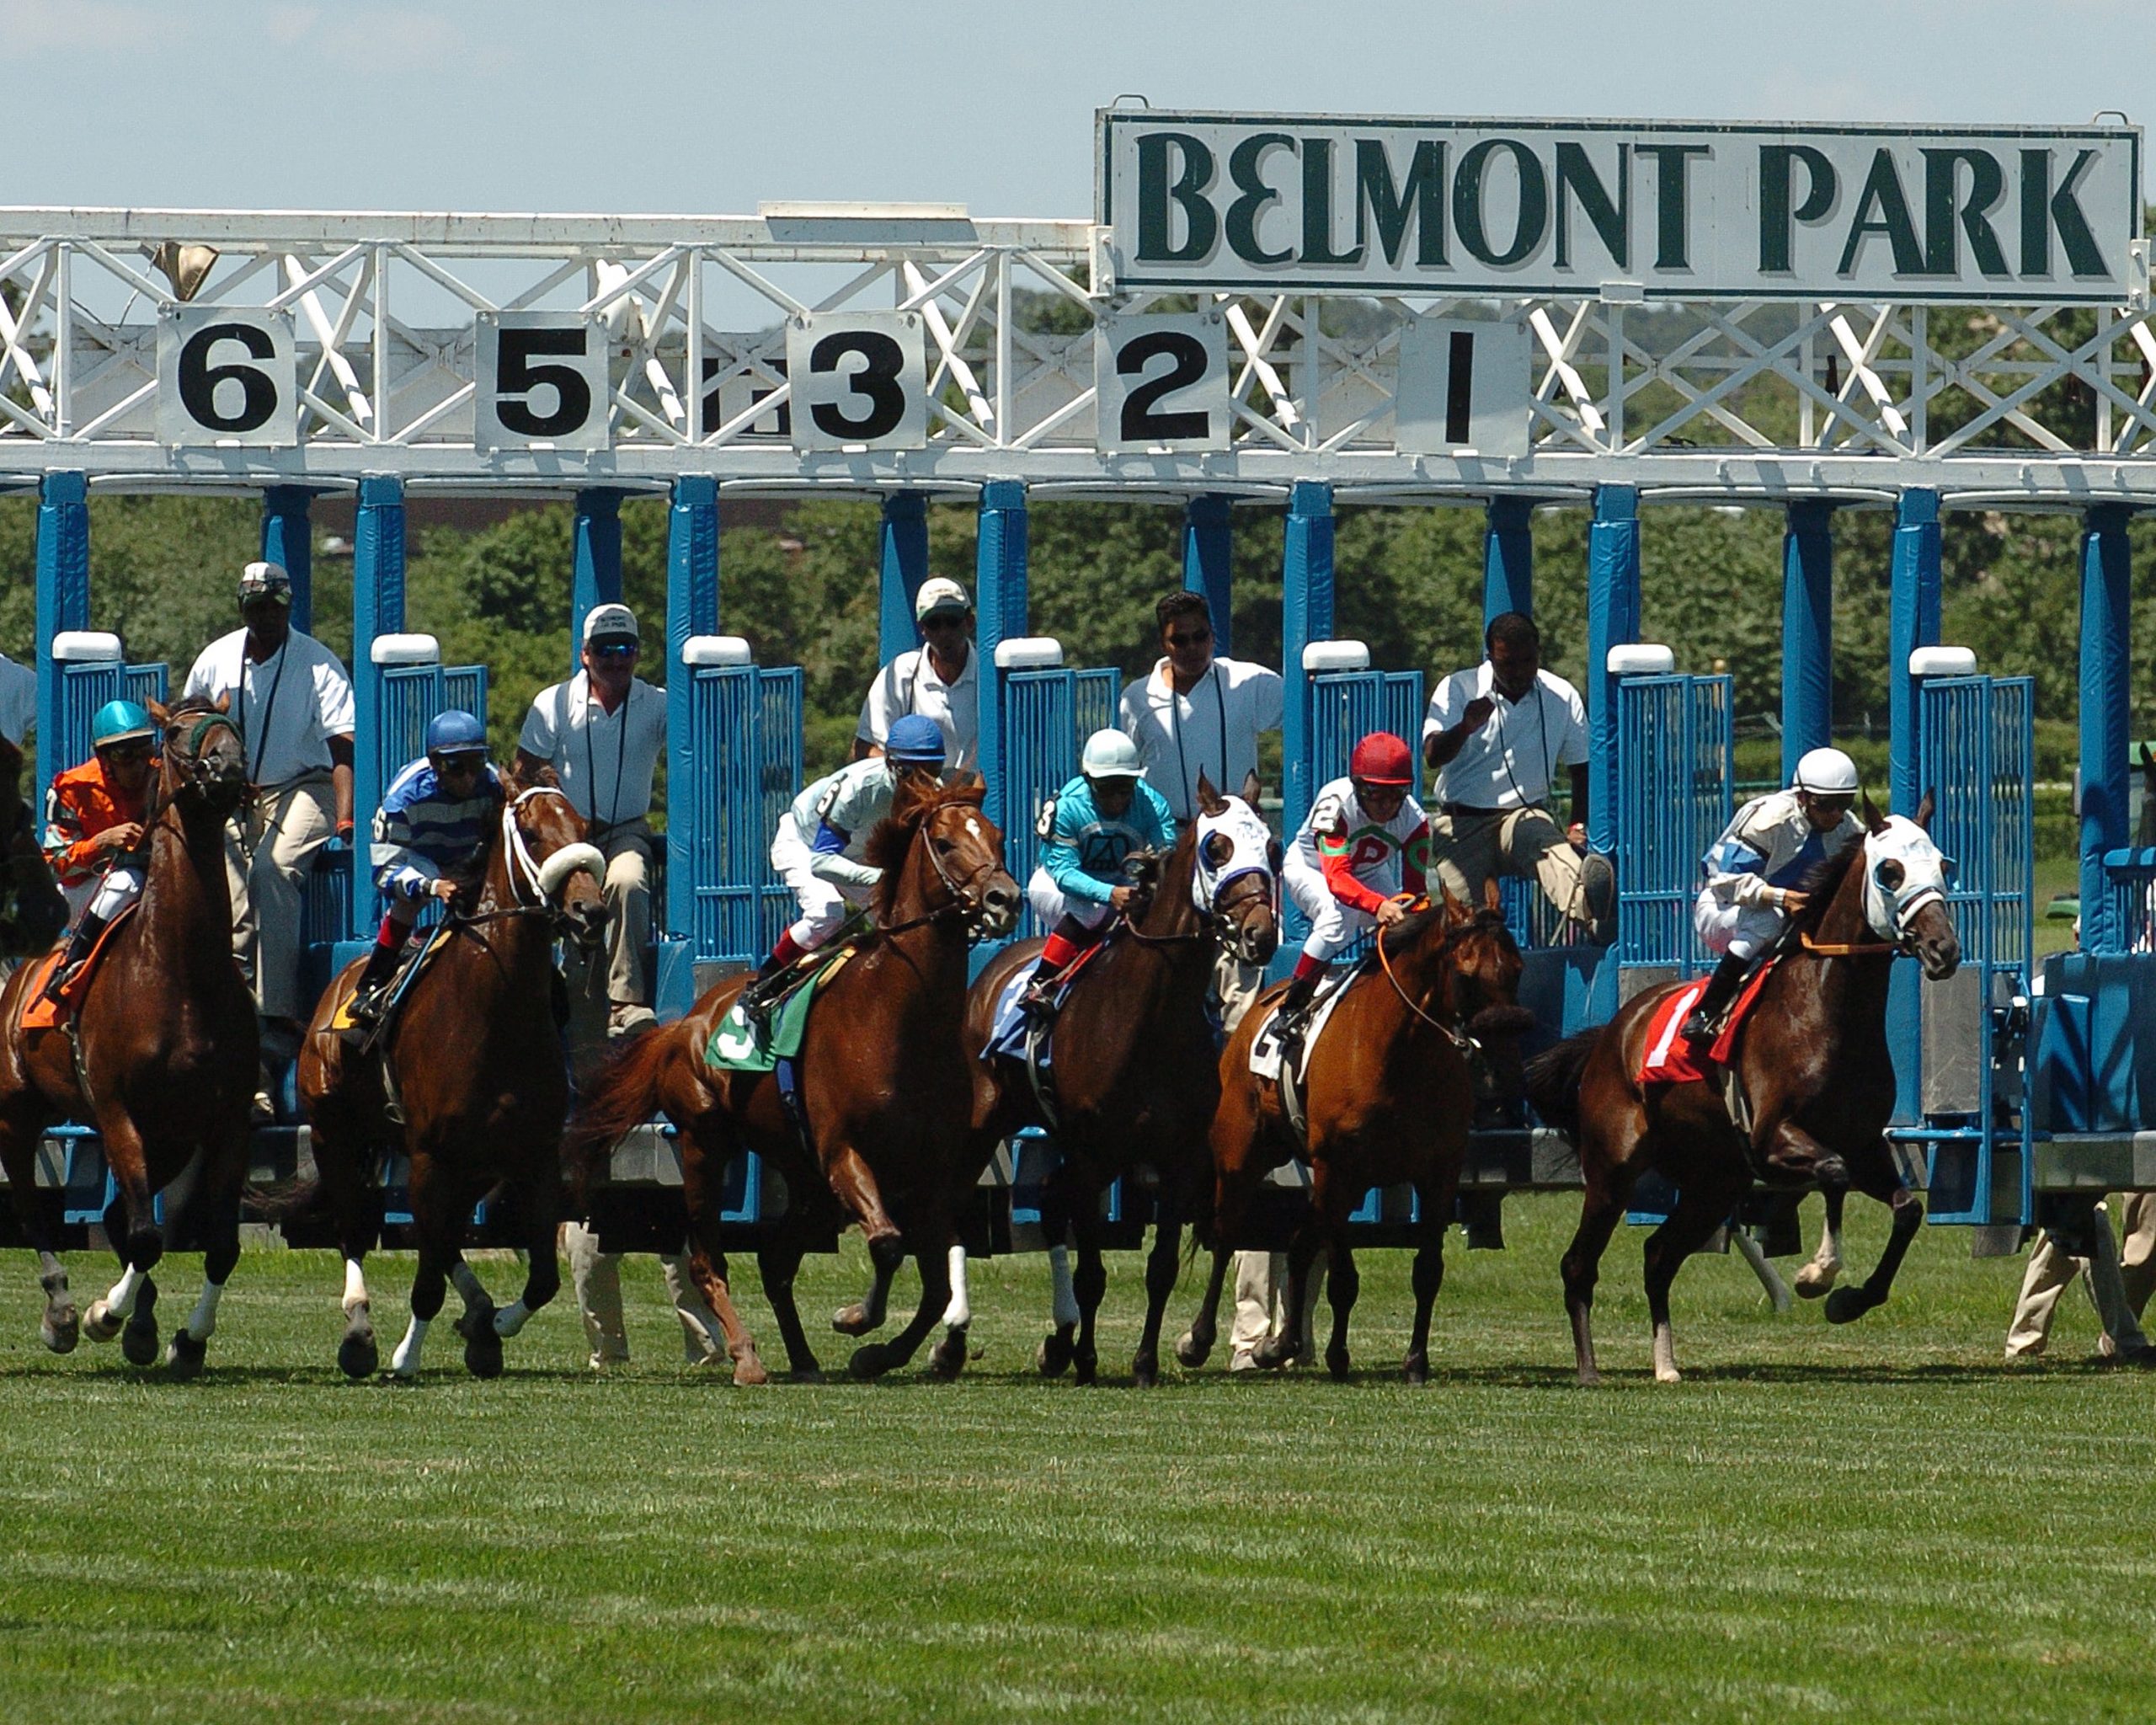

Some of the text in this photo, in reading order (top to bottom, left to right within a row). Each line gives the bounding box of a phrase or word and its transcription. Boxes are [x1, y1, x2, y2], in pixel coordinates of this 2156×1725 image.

[1135, 131, 2110, 276] BELMONT PARK
[178, 323, 278, 432] 6
[496, 328, 591, 437] 5
[810, 330, 905, 440] 3
[1116, 331, 1210, 441] 2
[1445, 331, 1474, 444] 1
[374, 806, 387, 841] 6
[817, 782, 840, 814] 5
[1037, 799, 1055, 836] 3
[1311, 794, 1341, 833] 2
[1646, 987, 1700, 1068] 1
